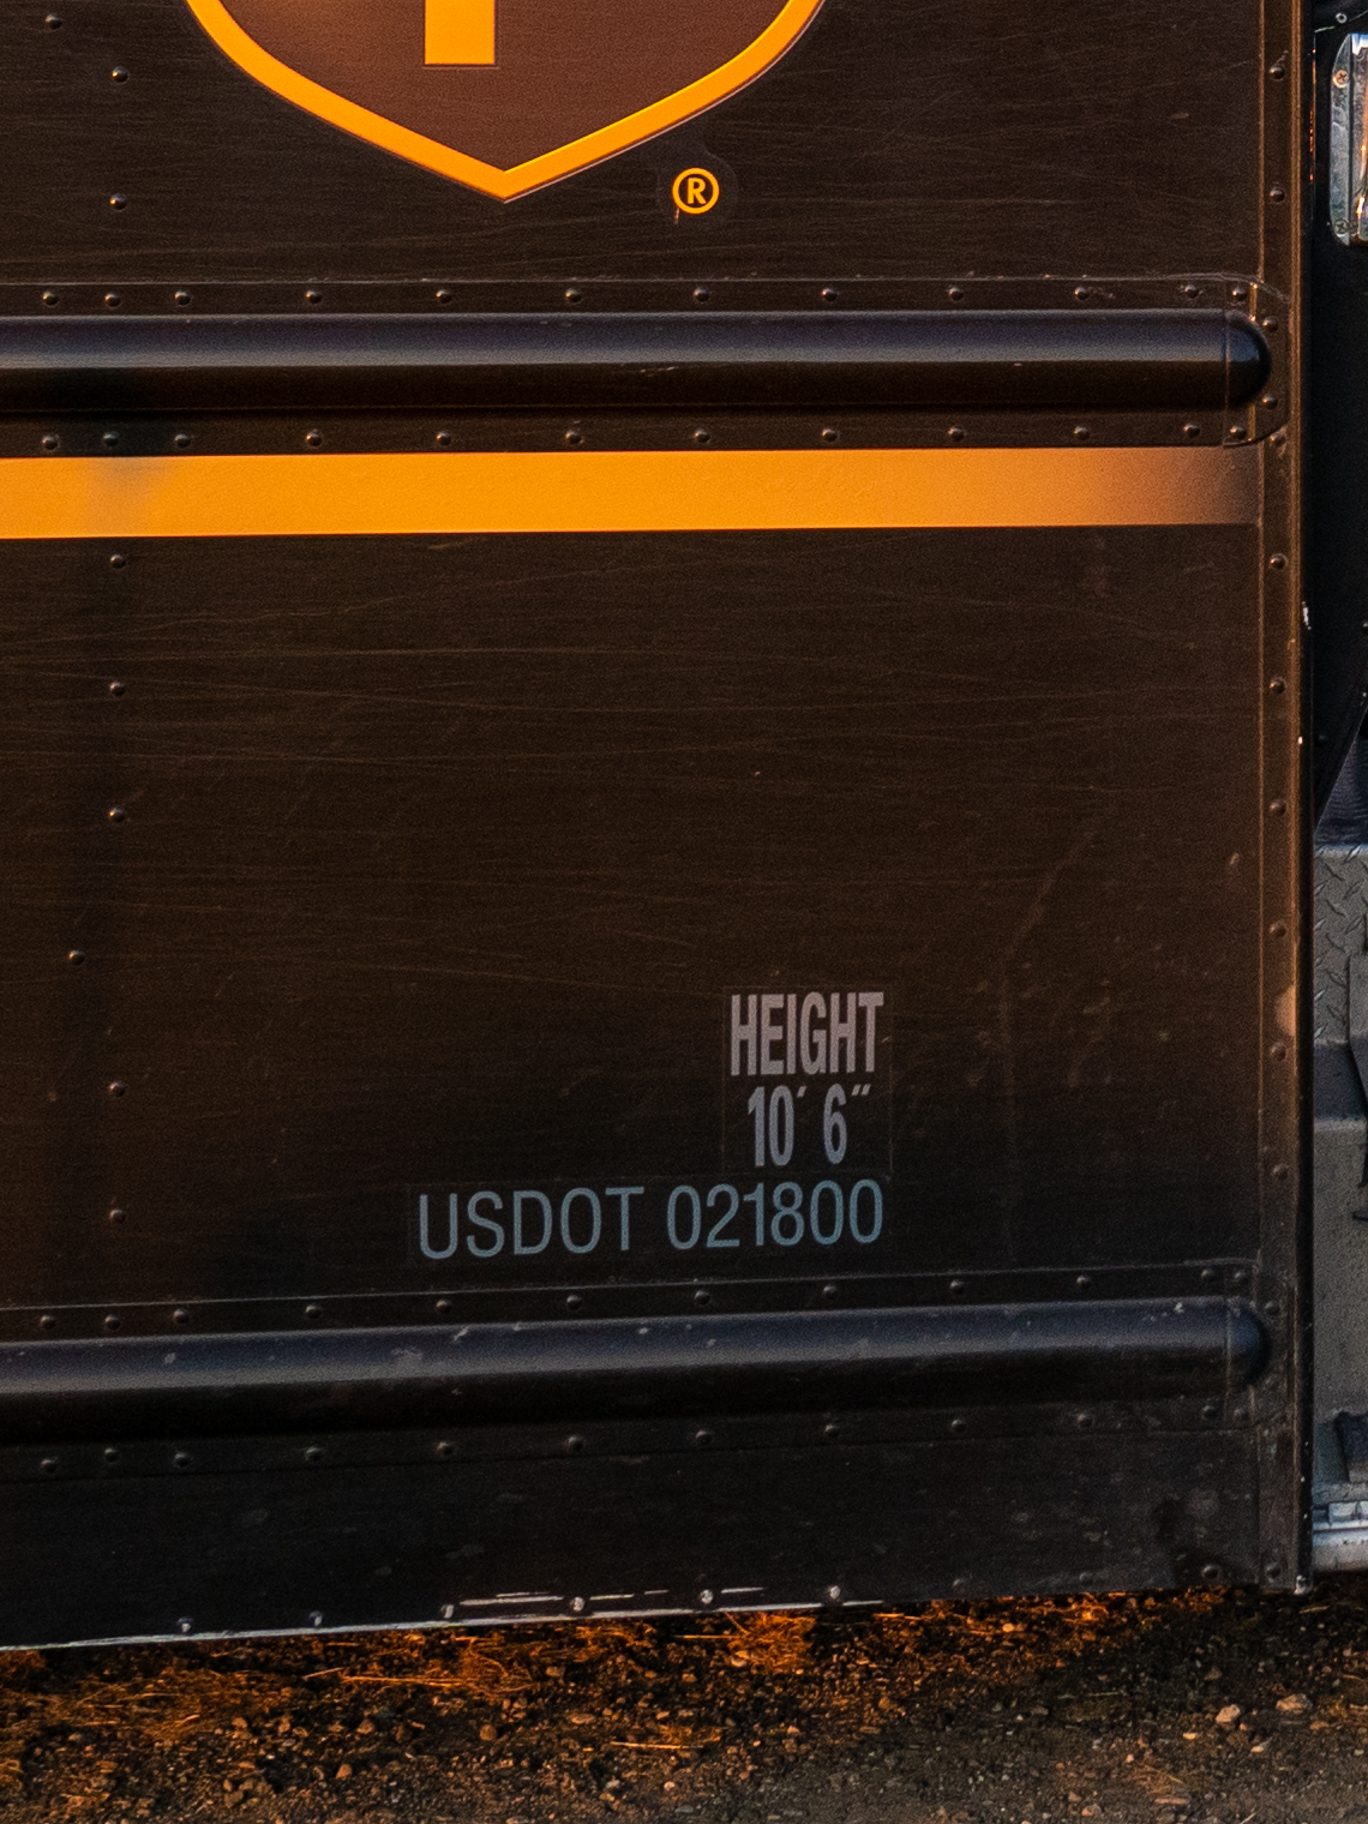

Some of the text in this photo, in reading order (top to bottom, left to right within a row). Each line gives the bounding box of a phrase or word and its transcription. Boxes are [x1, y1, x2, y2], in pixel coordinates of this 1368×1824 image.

[730, 991, 885, 1077] HEIGHT
[418, 1178, 885, 1260] USDOT 021800
